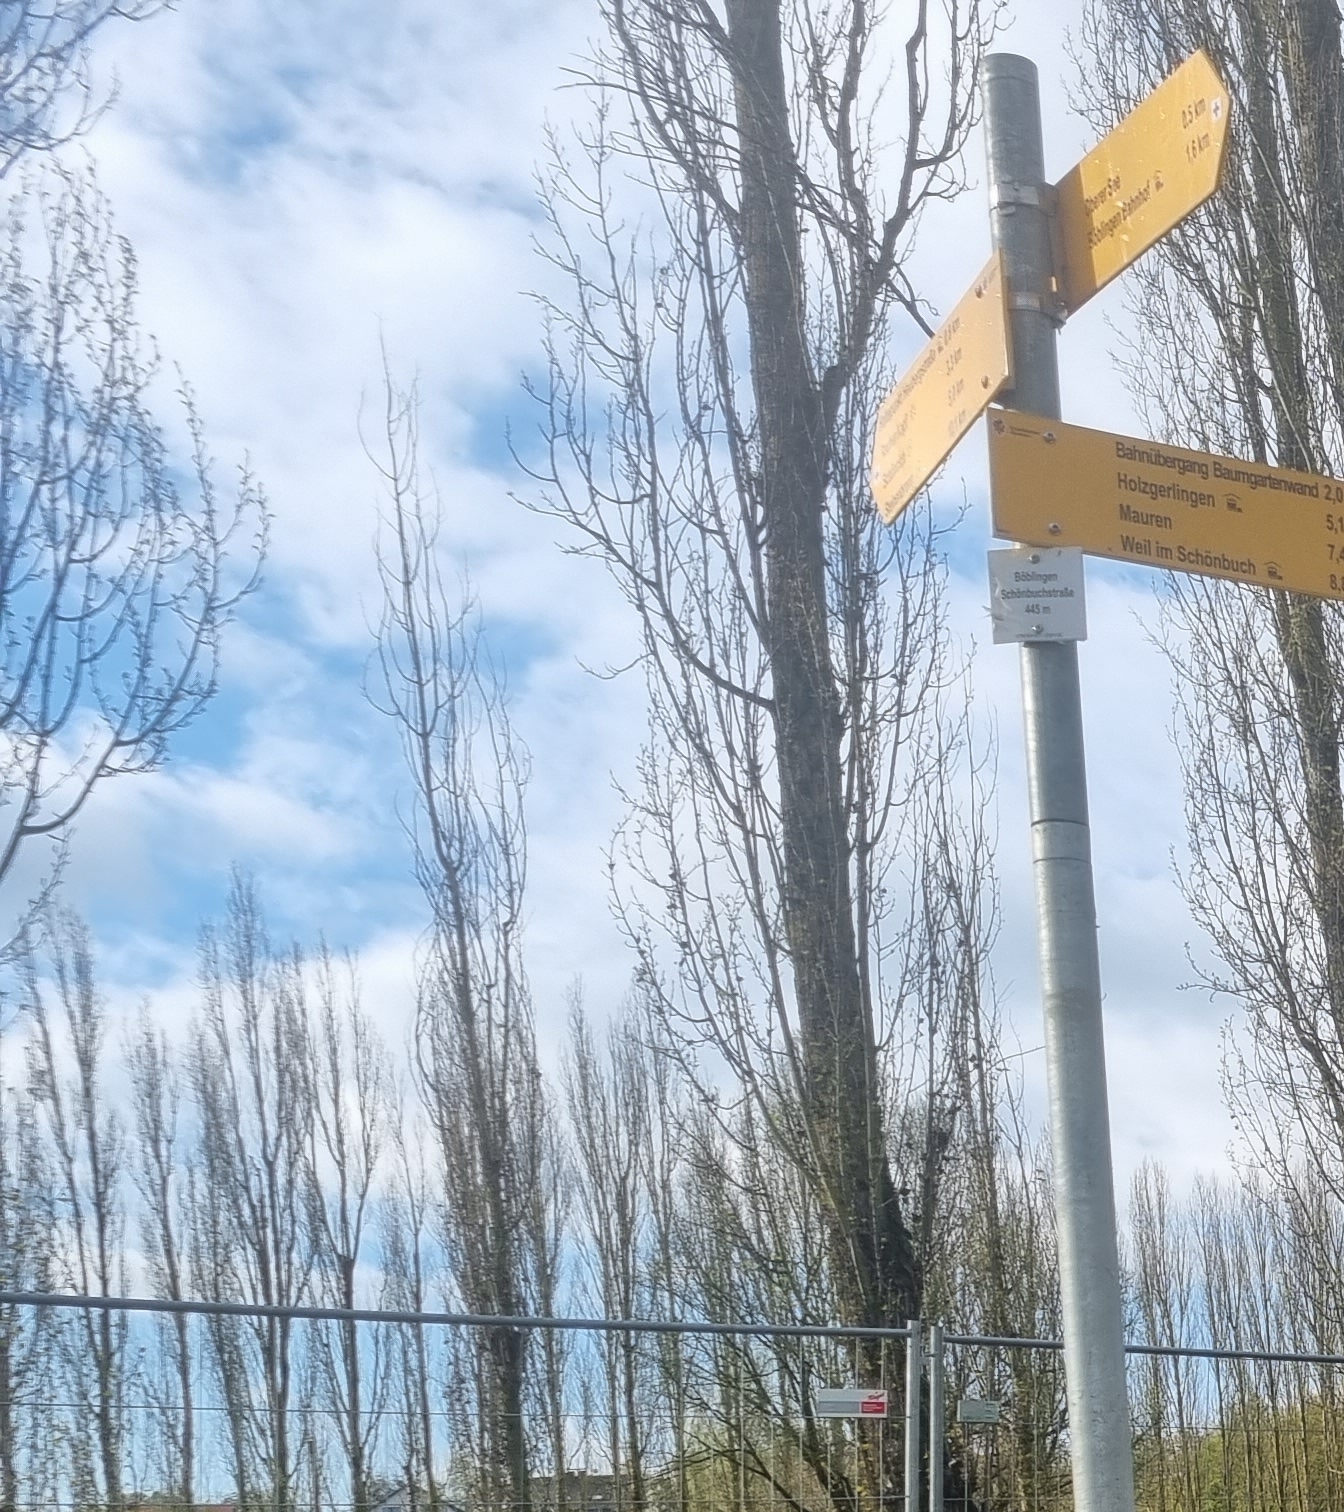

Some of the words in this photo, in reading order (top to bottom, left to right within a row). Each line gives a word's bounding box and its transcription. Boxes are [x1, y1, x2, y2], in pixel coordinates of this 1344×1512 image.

[1194, 98, 1206, 120] km
[1197, 133, 1210, 154] km
[1115, 442, 1209, 480] Bahnübergang
[1213, 461, 1319, 498] Baumgartenwand
[1117, 472, 1216, 508] Holzgerlingen
[1324, 484, 1343, 505] 2,0
[1119, 503, 1173, 530] Mauren
[1326, 514, 1344, 534] 5,1
[1120, 534, 1152, 557] Weil
[1156, 541, 1173, 560] im
[1177, 545, 1256, 576] Schönbuch
[1014, 571, 1058, 584] Böblingen
[1000, 587, 1075, 600] Schönbuchstraße
[1042, 605, 1051, 614] m
